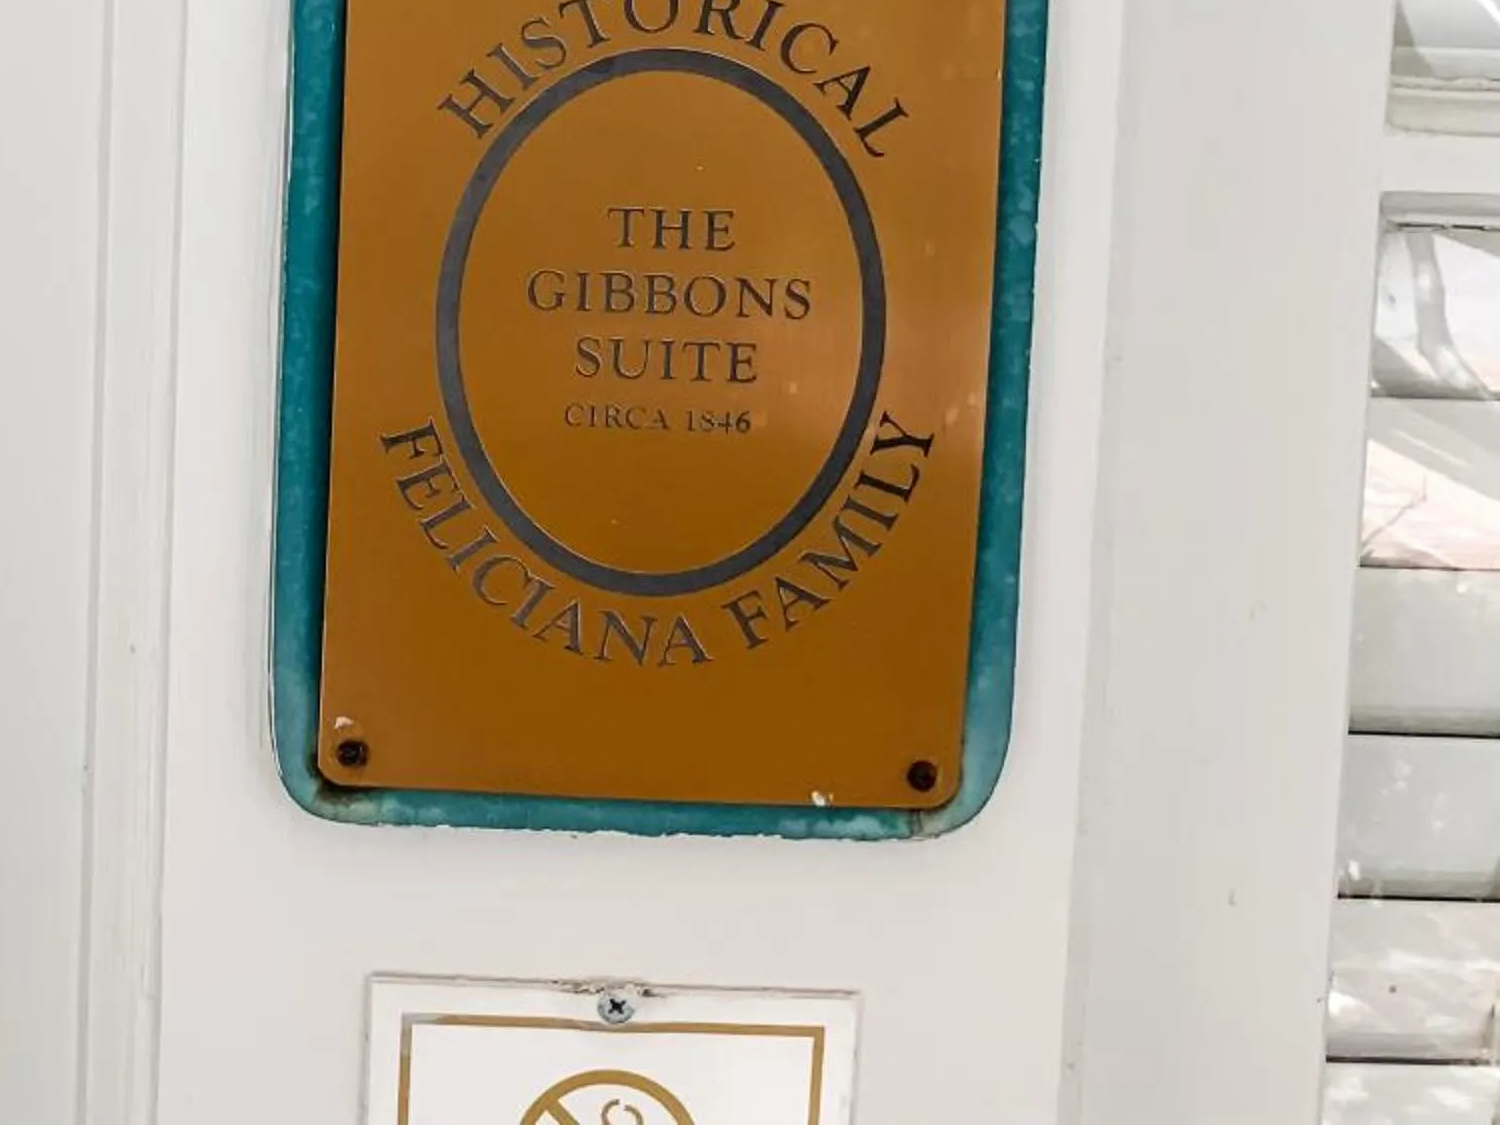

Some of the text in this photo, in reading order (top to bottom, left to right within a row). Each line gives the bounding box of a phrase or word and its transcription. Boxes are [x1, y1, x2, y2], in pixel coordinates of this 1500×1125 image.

[606, 206, 736, 252] THE
[526, 269, 813, 321] GIBBONS
[573, 336, 758, 384] SUITE
[563, 400, 753, 436] CIRCA 1846
[380, 411, 936, 668] FELICIANA FAMILY
